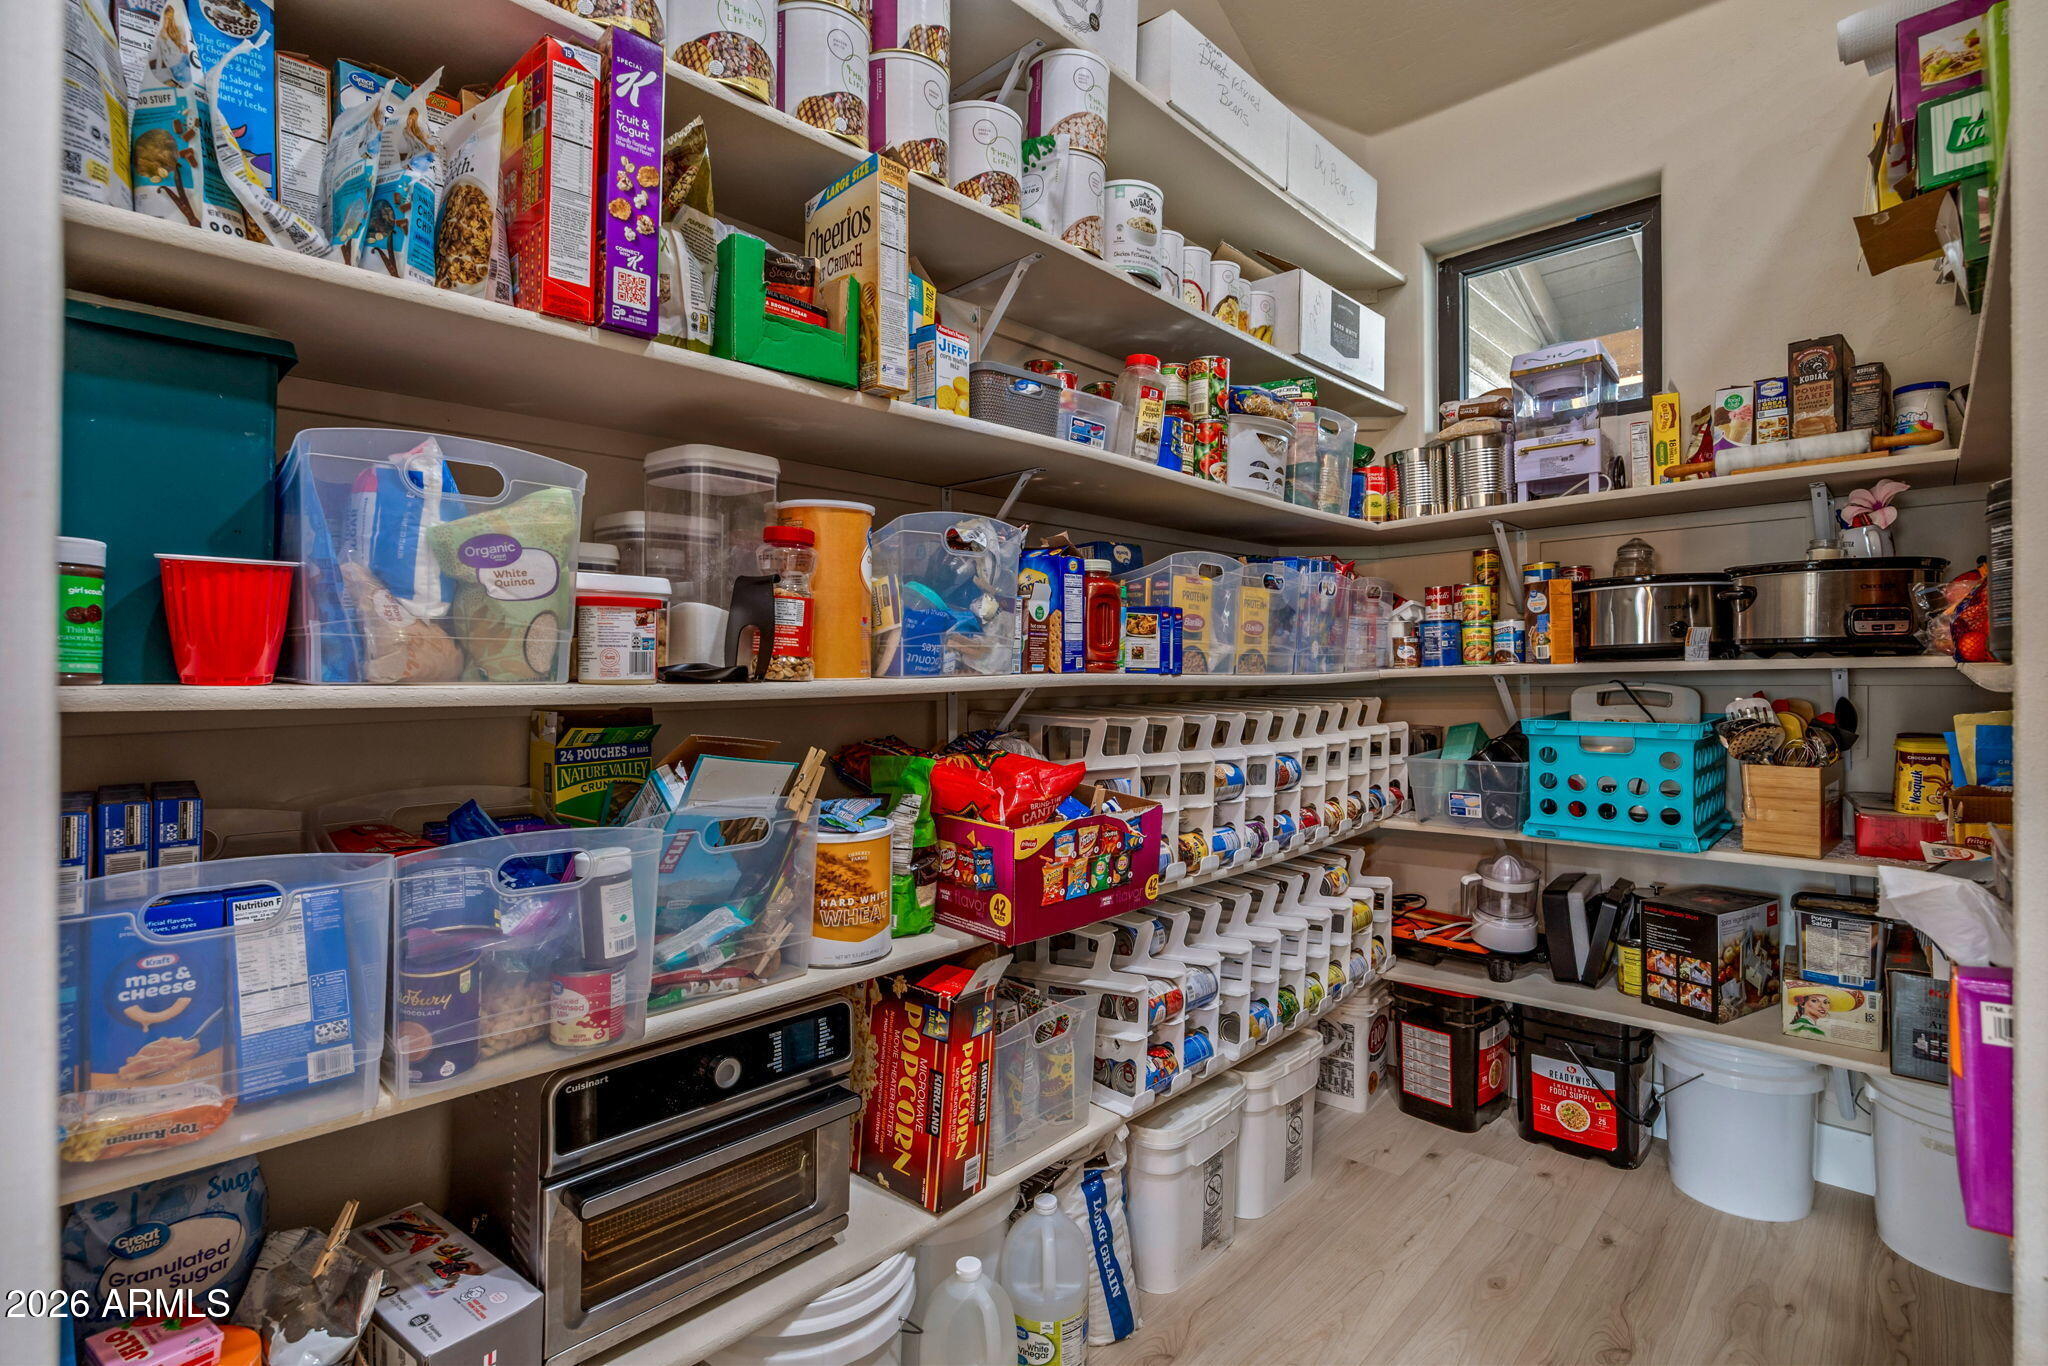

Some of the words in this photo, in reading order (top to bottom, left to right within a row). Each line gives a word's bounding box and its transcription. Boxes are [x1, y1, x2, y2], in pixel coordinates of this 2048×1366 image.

[199, 33, 214, 45] The
[249, 60, 266, 71] Chip
[616, 56, 643, 71] SPECIAL
[244, 68, 260, 78] Milk
[230, 74, 252, 88] Sabor
[254, 84, 264, 92] de
[616, 71, 657, 107] K
[151, 94, 172, 104] STUFF
[244, 90, 254, 98] de
[244, 100, 268, 113] Leche
[1217, 83, 1249, 127] Beans
[616, 110, 640, 126] Fruit
[642, 119, 650, 131] &
[616, 120, 650, 141] Yogurt
[880, 157, 906, 177] Cheerios
[826, 175, 850, 200] LARGE
[851, 161, 870, 183] SIZE
[1129, 199, 1158, 215] AUGASON
[808, 206, 871, 258] Cheerios
[615, 245, 640, 256] CONNECT
[827, 243, 863, 276] CRUNCH
[769, 266, 795, 278] Steel
[925, 287, 934, 300] 20
[770, 302, 790, 312] BROWN
[791, 307, 808, 318] SUGAR
[938, 338, 968, 359] JIFFY
[1799, 371, 1828, 384] KODIAK
[1795, 384, 1832, 396] POWER
[1796, 391, 1831, 402] CAKES
[1758, 396, 1787, 404] DISCOVER
[1145, 405, 1160, 413] Black
[1669, 439, 1677, 447] 18
[464, 543, 516, 558] Organic
[493, 569, 528, 578] White
[67, 586, 83, 595] girl
[494, 578, 536, 588] Quinoa
[1182, 590, 1209, 602] PROTEIN+
[1184, 618, 1204, 627] Barilla
[1245, 624, 1263, 632] Barilla
[560, 750, 574, 762] 24
[577, 745, 628, 760] POUCHES
[560, 765, 608, 788] NATURE
[609, 761, 648, 778] VALLEY
[1909, 770, 1925, 805] Nesquik
[1030, 800, 1050, 810] BRING
[1148, 877, 1158, 890] 42
[234, 900, 275, 912] Nutrition
[821, 898, 854, 907] HARD
[860, 890, 888, 902] WHITE
[954, 889, 987, 914] flavor
[820, 901, 887, 928] WHEAT
[993, 898, 1006, 916] 42
[167, 917, 194, 926] flavors,
[180, 922, 197, 930] dyes
[1811, 914, 1833, 923] Potato
[1811, 920, 1832, 928] Salad
[145, 957, 170, 966] Kraft
[125, 972, 174, 988] mac
[175, 966, 191, 981] &
[892, 1029, 901, 1058] MOVIE
[565, 1075, 609, 1094] Cuisinart
[889, 1061, 898, 1101] THEATER
[1549, 1069, 1596, 1087] READYWISE
[892, 1001, 923, 1176] POPCORN
[915, 1057, 928, 1134] MICROWAVE
[968, 1071, 978, 1122] MICROWAVE
[978, 1063, 989, 1122] KIRKLAND
[1549, 1087, 1567, 1097] FOOD
[1569, 1092, 1596, 1103] SUPPLY
[1553, 1083, 1590, 1095] EMERGENCY
[931, 1073, 943, 1136] KIRKLAND
[954, 1041, 975, 1160] POPCORN
[1540, 1103, 1550, 1111] 124
[886, 1102, 896, 1137] BUTTER
[1598, 1118, 1607, 1126] 25
[107, 1129, 166, 1145] Ramen
[170, 1123, 199, 1136] Top
[1093, 1197, 1108, 1242] LONG
[115, 1228, 161, 1249] Great
[126, 1238, 161, 1255] Value
[108, 1240, 231, 1288] Granulated
[1100, 1244, 1122, 1299] GRAIN
[169, 1257, 230, 1289] Sugar
[1017, 1345, 1049, 1360] Vinegar
[1026, 1343, 1050, 1354] White
